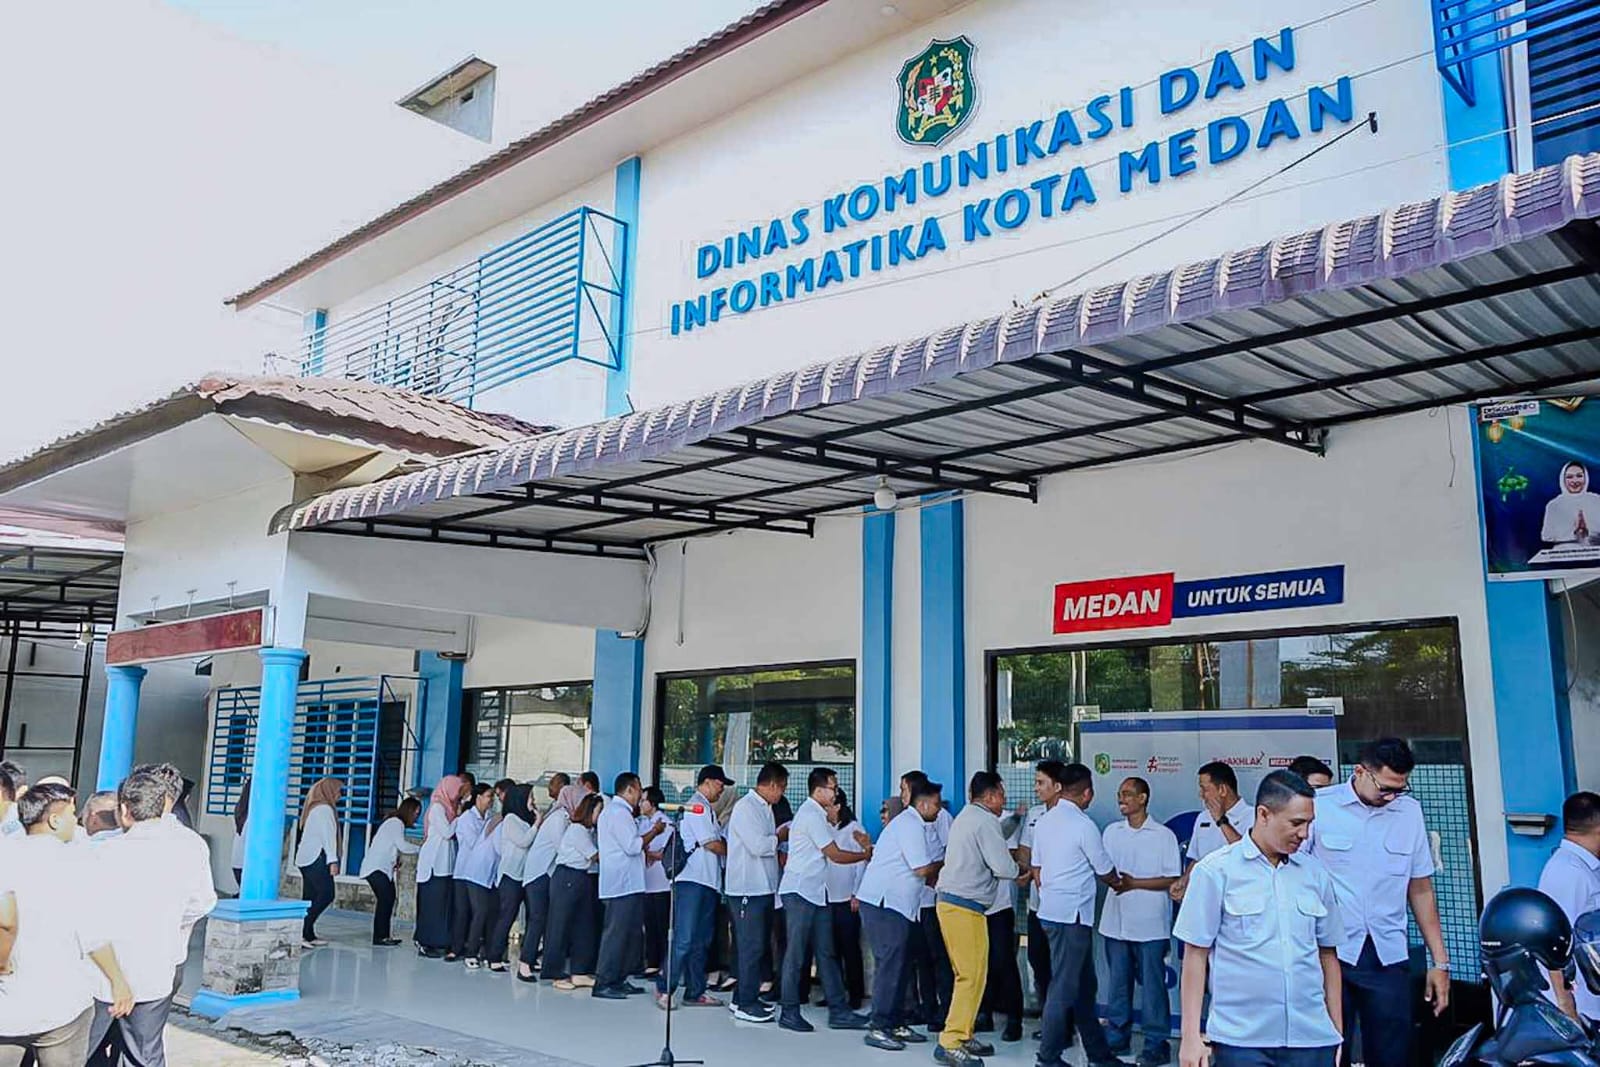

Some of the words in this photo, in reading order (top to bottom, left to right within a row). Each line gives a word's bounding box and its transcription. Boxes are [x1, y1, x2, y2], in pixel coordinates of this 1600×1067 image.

[671, 216, 947, 336] INFORMATIKA
[963, 166, 1097, 242] KOTA
[1118, 75, 1354, 193] MEDAN
[697, 208, 810, 279] DINAS
[823, 86, 1134, 234] KOMUNIKASI
[1159, 27, 1296, 115] DAN
[1062, 588, 1161, 621] MEDAN
[1187, 584, 1252, 608] UNTUK
[1254, 577, 1326, 601] SEMUA
